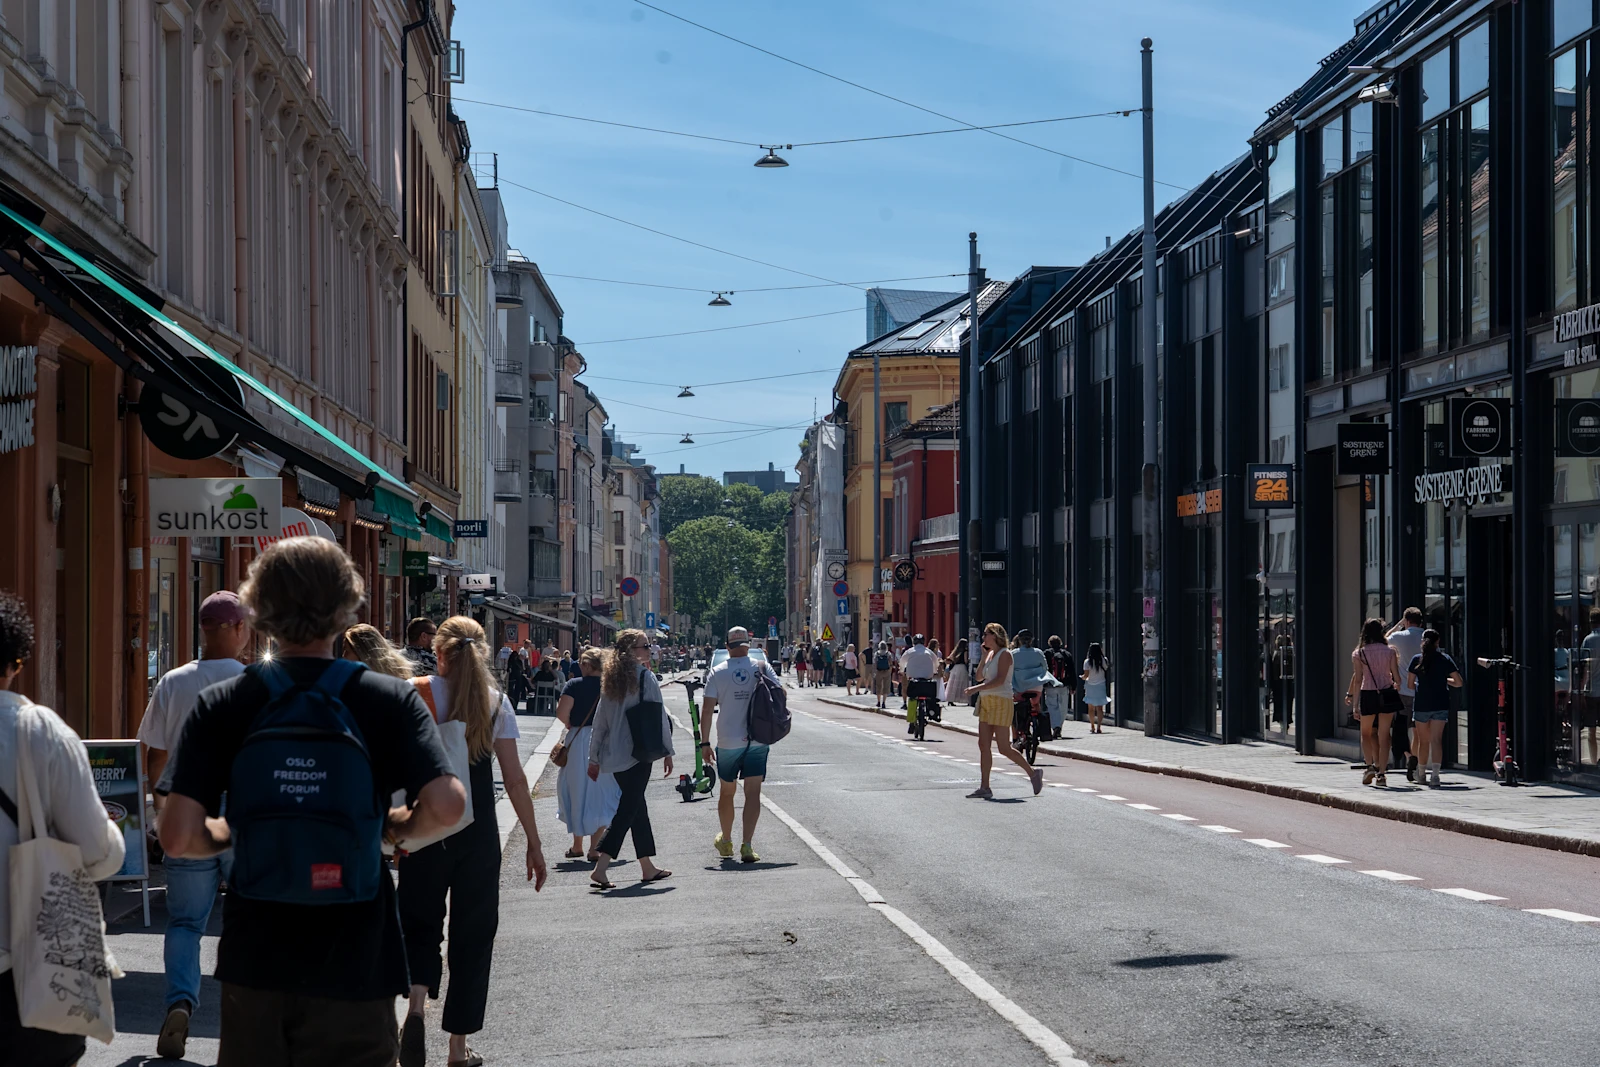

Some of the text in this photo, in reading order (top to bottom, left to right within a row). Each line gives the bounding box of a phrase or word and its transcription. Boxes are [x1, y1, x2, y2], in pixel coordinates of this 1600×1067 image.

[1564, 344, 1597, 367] BAR & SPILL
[0, 345, 38, 397] OOTHIE
[0, 399, 35, 454] HANGE
[1342, 441, 1384, 450] SØSTRENE
[1350, 448, 1378, 458] GRENE
[1256, 479, 1289, 492] 24
[1415, 469, 1465, 508] SØSTRENE
[1466, 464, 1502, 506] GRENE
[1254, 492, 1288, 501] SEVEN
[158, 506, 270, 530] sunkost
[456, 522, 482, 532] norli
[286, 757, 316, 767] OSLO
[274, 770, 327, 780] FREEDOM
[96, 781, 111, 793] SH
[280, 784, 320, 794] FORUM
